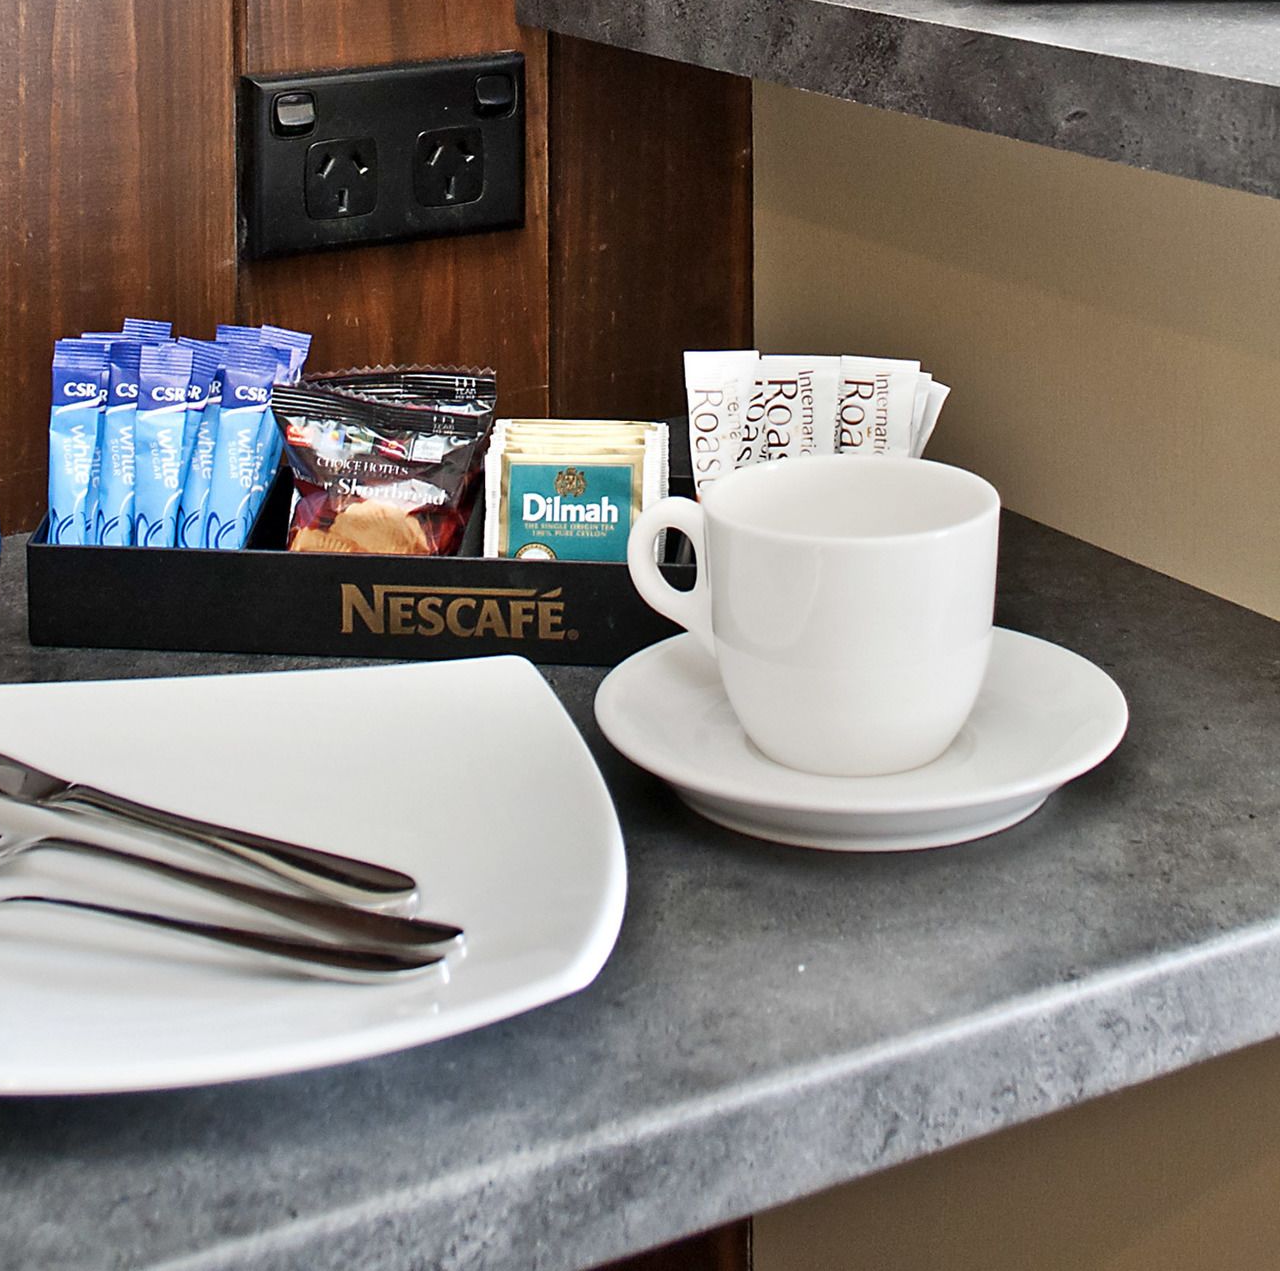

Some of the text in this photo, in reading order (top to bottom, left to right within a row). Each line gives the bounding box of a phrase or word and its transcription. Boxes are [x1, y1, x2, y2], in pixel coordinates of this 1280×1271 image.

[63, 381, 97, 397] CSR
[115, 382, 139, 398] CS
[151, 386, 187, 402] CSR
[234, 385, 268, 403] CSR
[316, 457, 410, 476] CHOICE HOTELS
[337, 478, 447, 506] Shortbread
[522, 492, 619, 523] Dilmah
